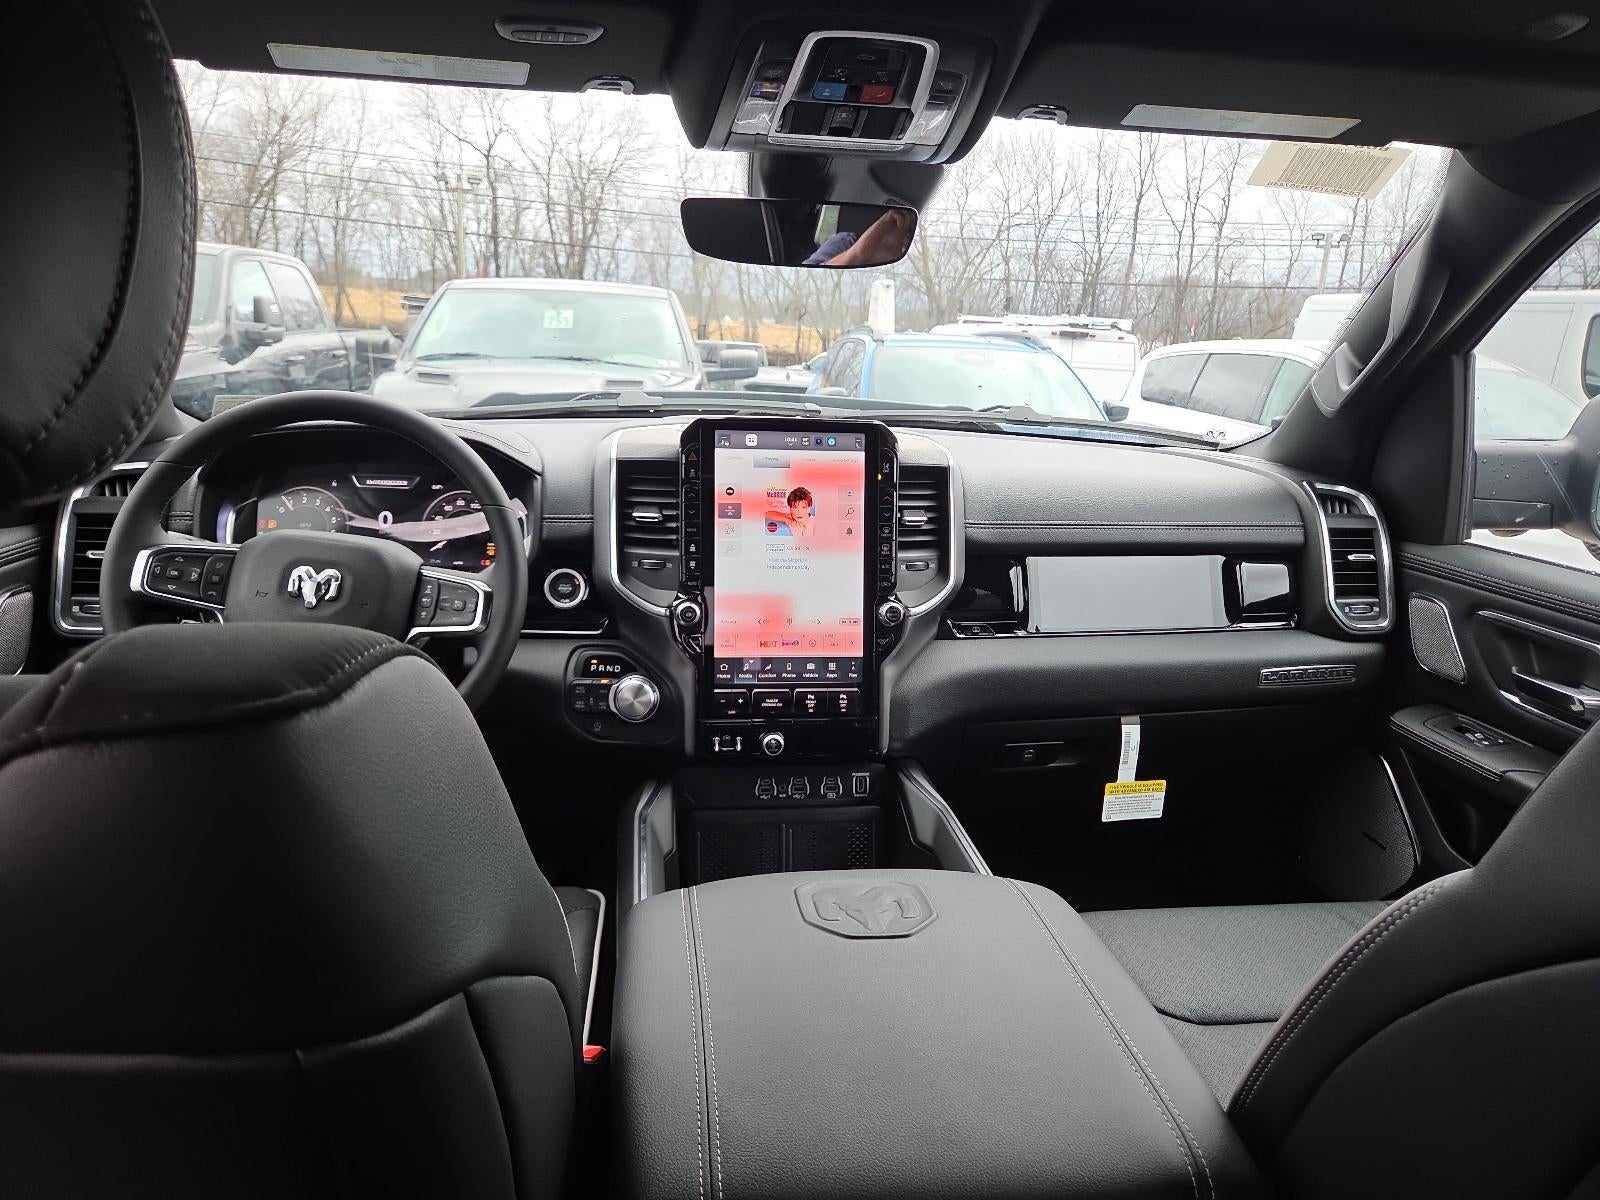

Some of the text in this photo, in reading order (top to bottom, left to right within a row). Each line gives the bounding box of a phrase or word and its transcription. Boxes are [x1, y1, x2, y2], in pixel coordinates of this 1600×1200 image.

[301, 496, 308, 504] 2
[315, 498, 321, 506] 3
[331, 516, 337, 524] 5
[378, 510, 393, 528] 0
[759, 640, 778, 648] HEAT
